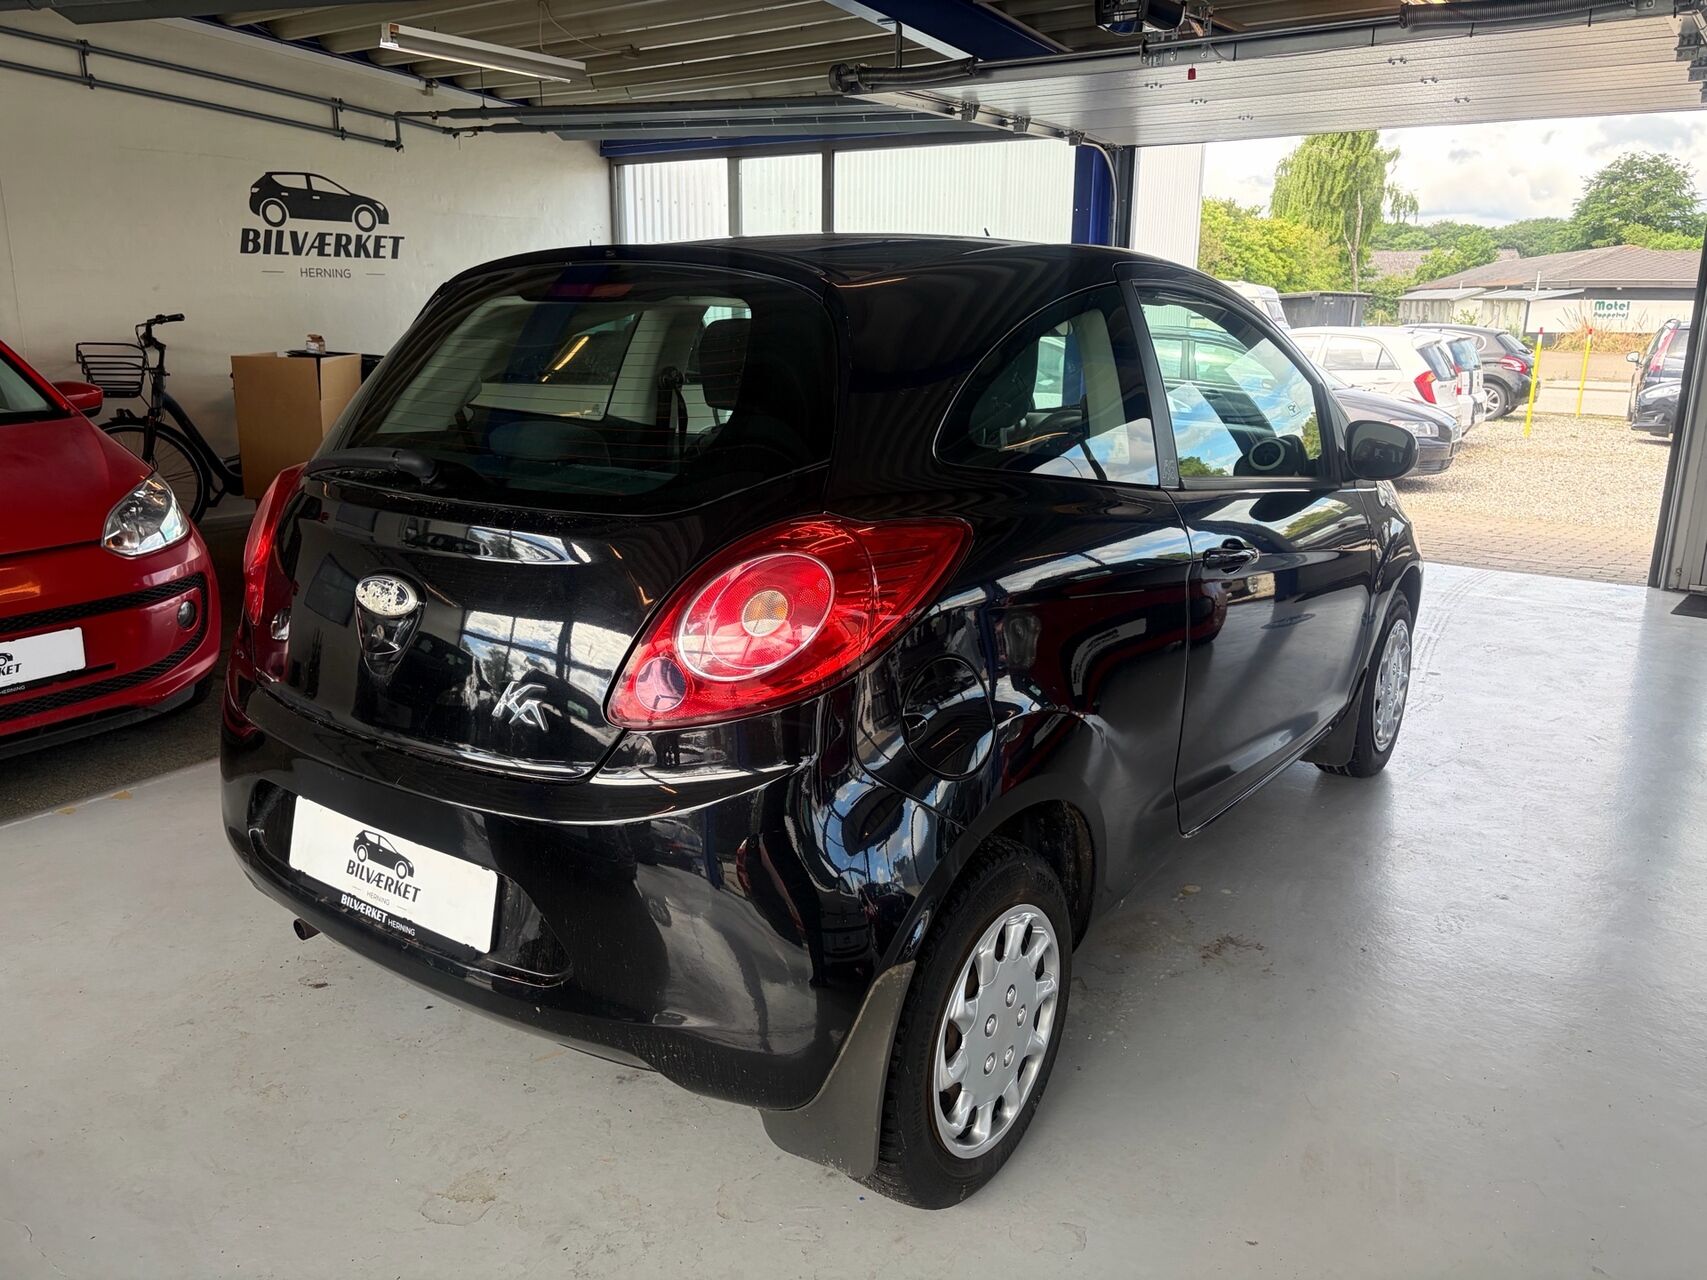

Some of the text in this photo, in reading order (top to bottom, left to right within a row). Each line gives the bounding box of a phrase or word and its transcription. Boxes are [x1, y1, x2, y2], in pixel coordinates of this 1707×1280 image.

[240, 228, 405, 259] BILVÆRKET
[300, 268, 351, 279] HERNING
[1594, 301, 1630, 311] Motel
[346, 859, 421, 903] BILVÆRKET
[341, 894, 416, 936] BILVÆRKET HERNING
